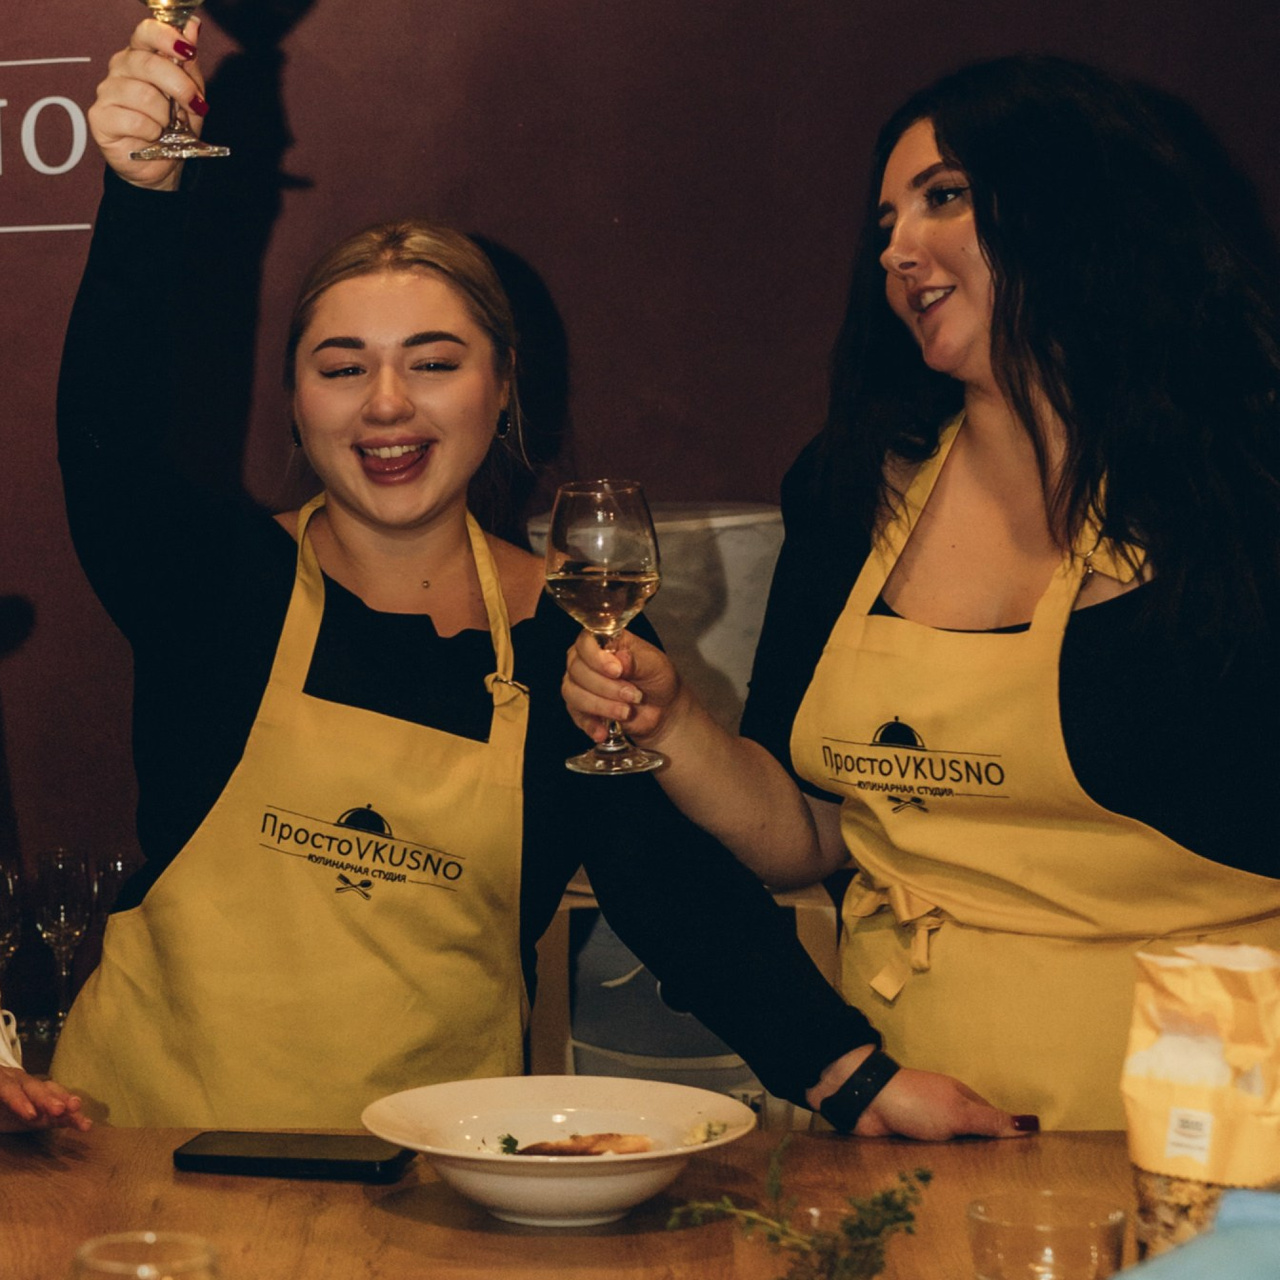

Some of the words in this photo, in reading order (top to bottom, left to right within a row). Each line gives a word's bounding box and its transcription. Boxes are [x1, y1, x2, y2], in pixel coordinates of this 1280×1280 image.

[822, 745, 1005, 786] ПростоVKUSNO
[857, 780, 915, 794] КУЛИНАРНАЯ
[916, 785, 954, 797] СТУДИЯ
[261, 812, 463, 881] ПростоVKUSNO
[307, 853, 369, 876] КУЛИНАРНАЯ
[371, 868, 407, 883] СТУДИЯ
